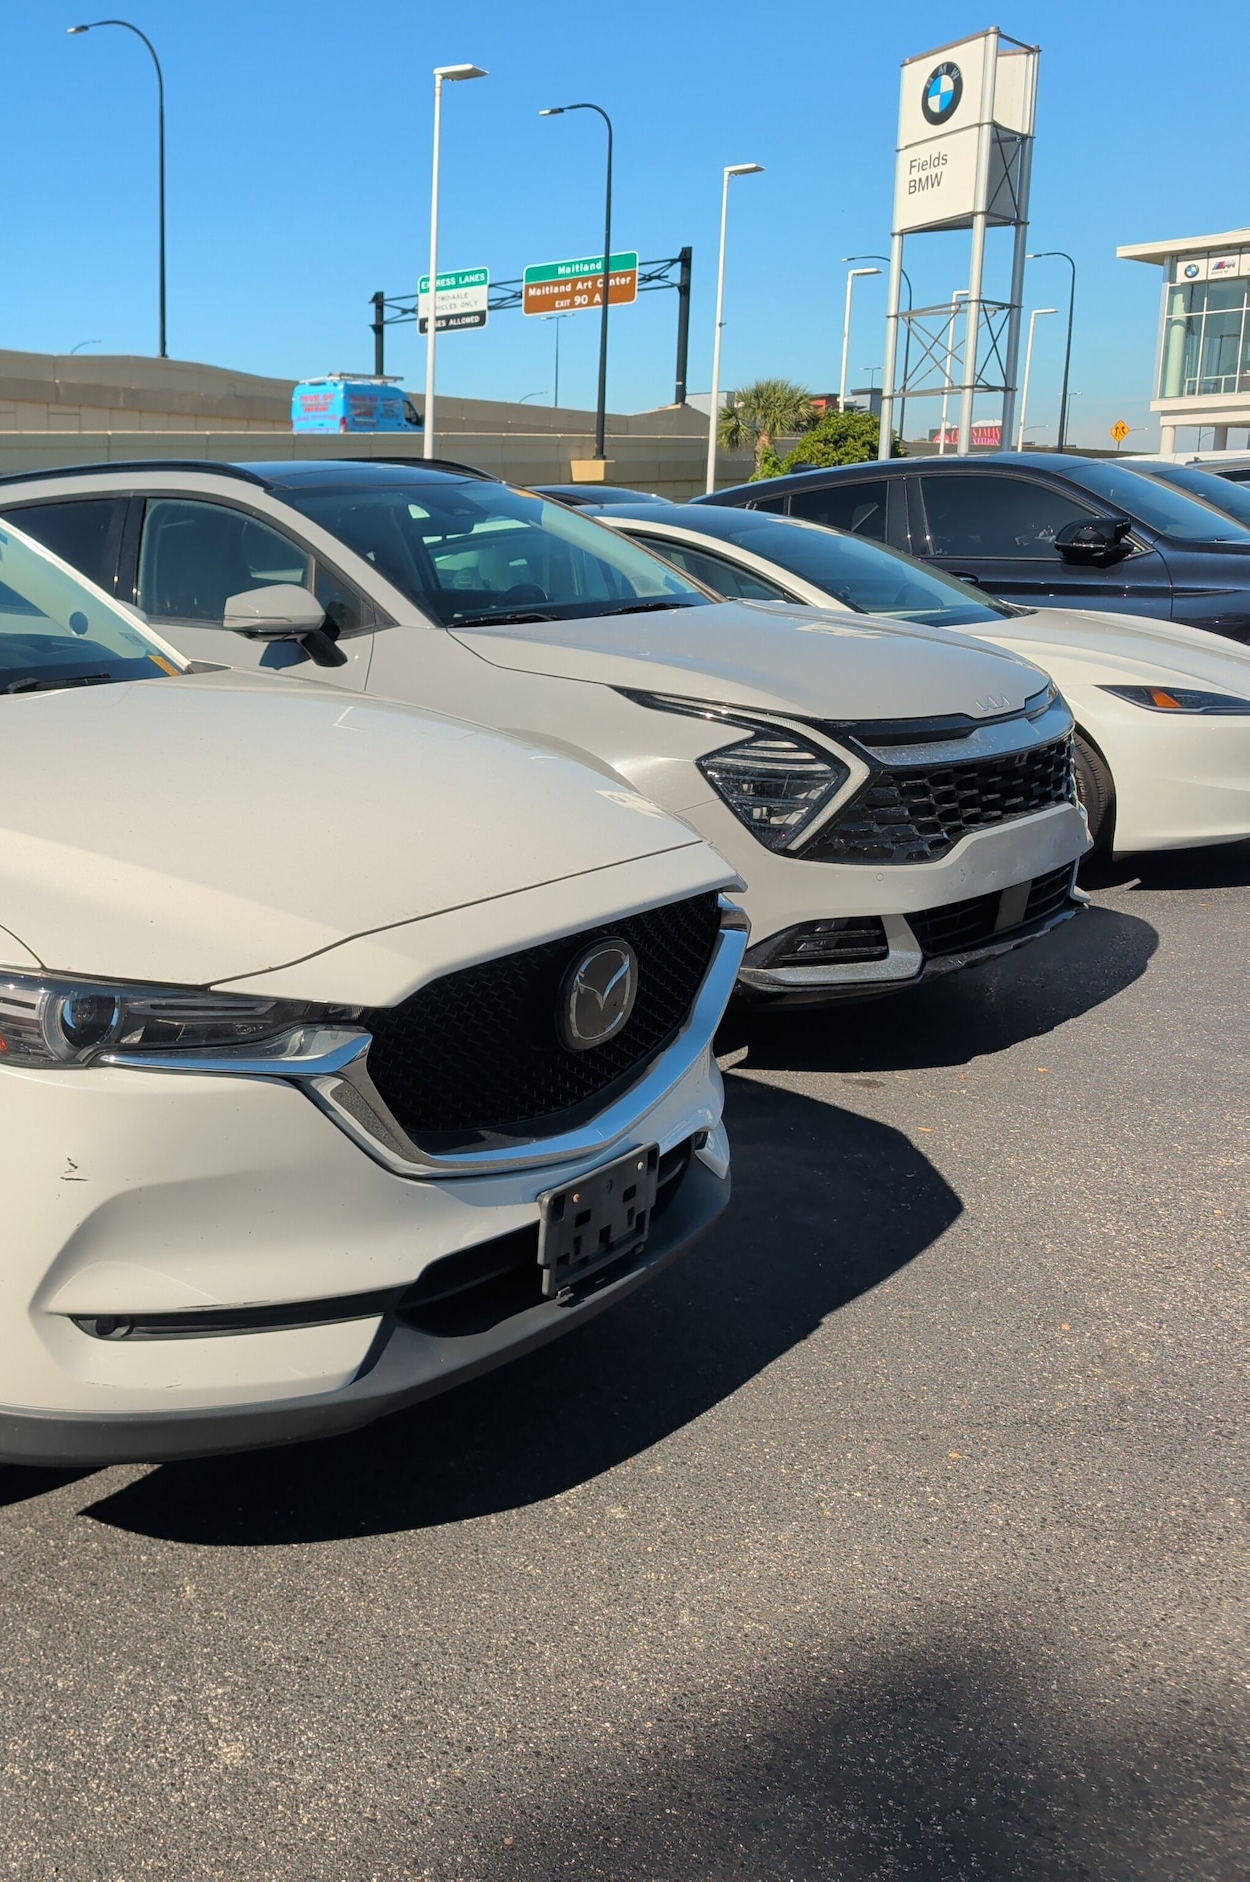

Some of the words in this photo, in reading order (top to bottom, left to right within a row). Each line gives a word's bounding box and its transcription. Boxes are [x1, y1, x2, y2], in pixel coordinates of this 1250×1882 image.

[909, 152, 948, 175] Fields
[908, 171, 943, 195] BMW
[558, 261, 603, 275] Maitland
[421, 276, 456, 290] EXRESS
[459, 272, 486, 284] LANES
[528, 282, 572, 297] Maitland
[576, 280, 593, 290] Art
[597, 276, 632, 288] Cnter
[555, 299, 571, 308] EXIT
[574, 295, 588, 305] 90
[424, 319, 447, 330] BSES
[448, 315, 480, 327] ALLOWED
